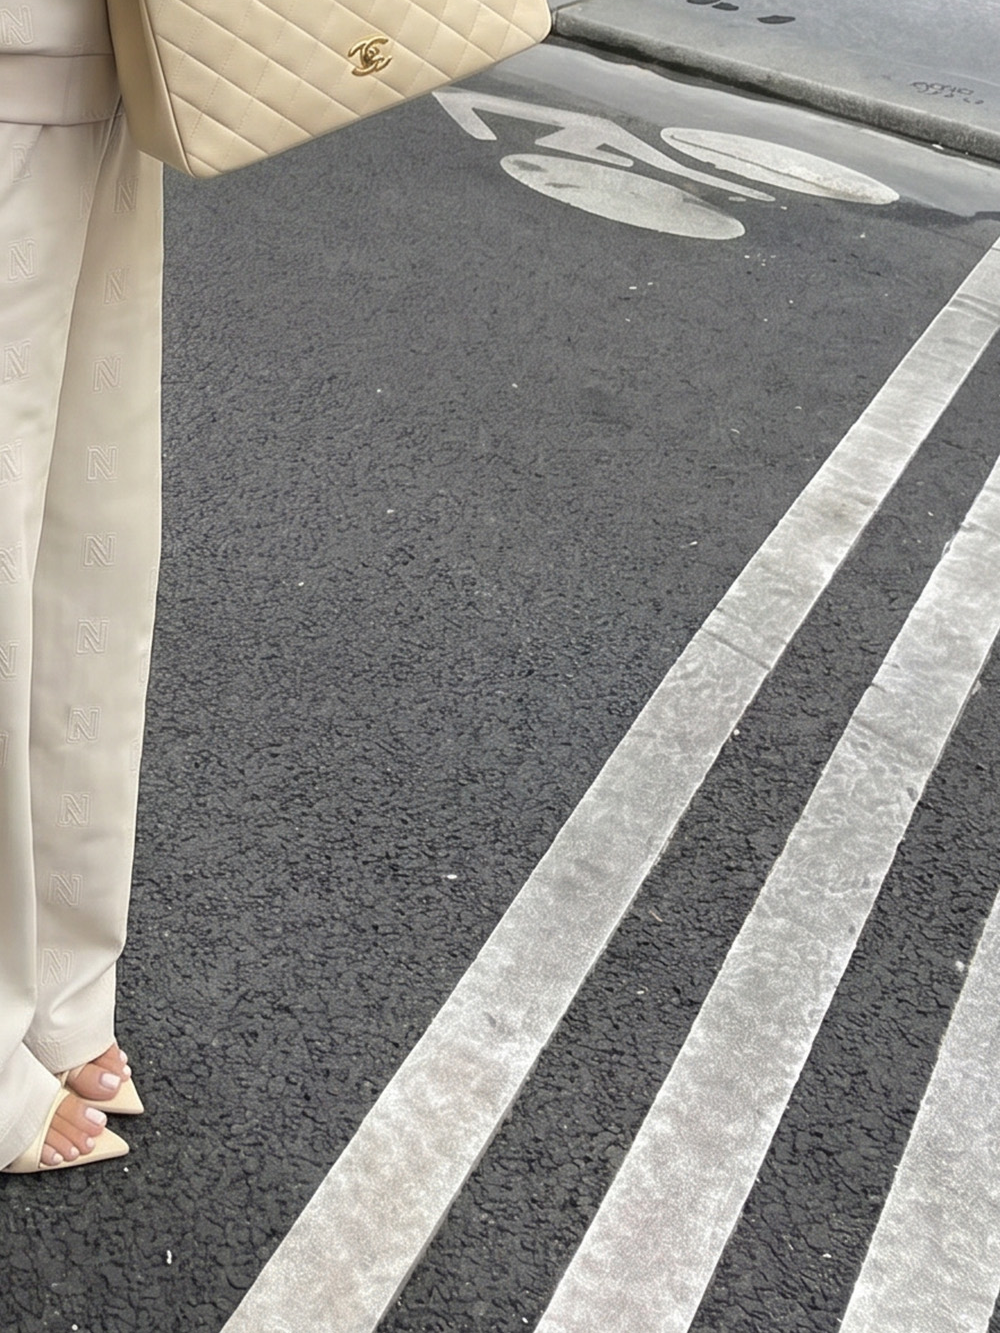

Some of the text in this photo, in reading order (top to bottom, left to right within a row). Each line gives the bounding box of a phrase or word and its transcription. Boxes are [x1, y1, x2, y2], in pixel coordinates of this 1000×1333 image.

[7, 238, 37, 283] N
[2, 339, 31, 384] N
[92, 355, 122, 393] N
[86, 444, 119, 483] N
[83, 532, 117, 568] N
[75, 619, 110, 655] N
[66, 707, 100, 744] N
[57, 792, 91, 827] N
[48, 873, 83, 908] N
